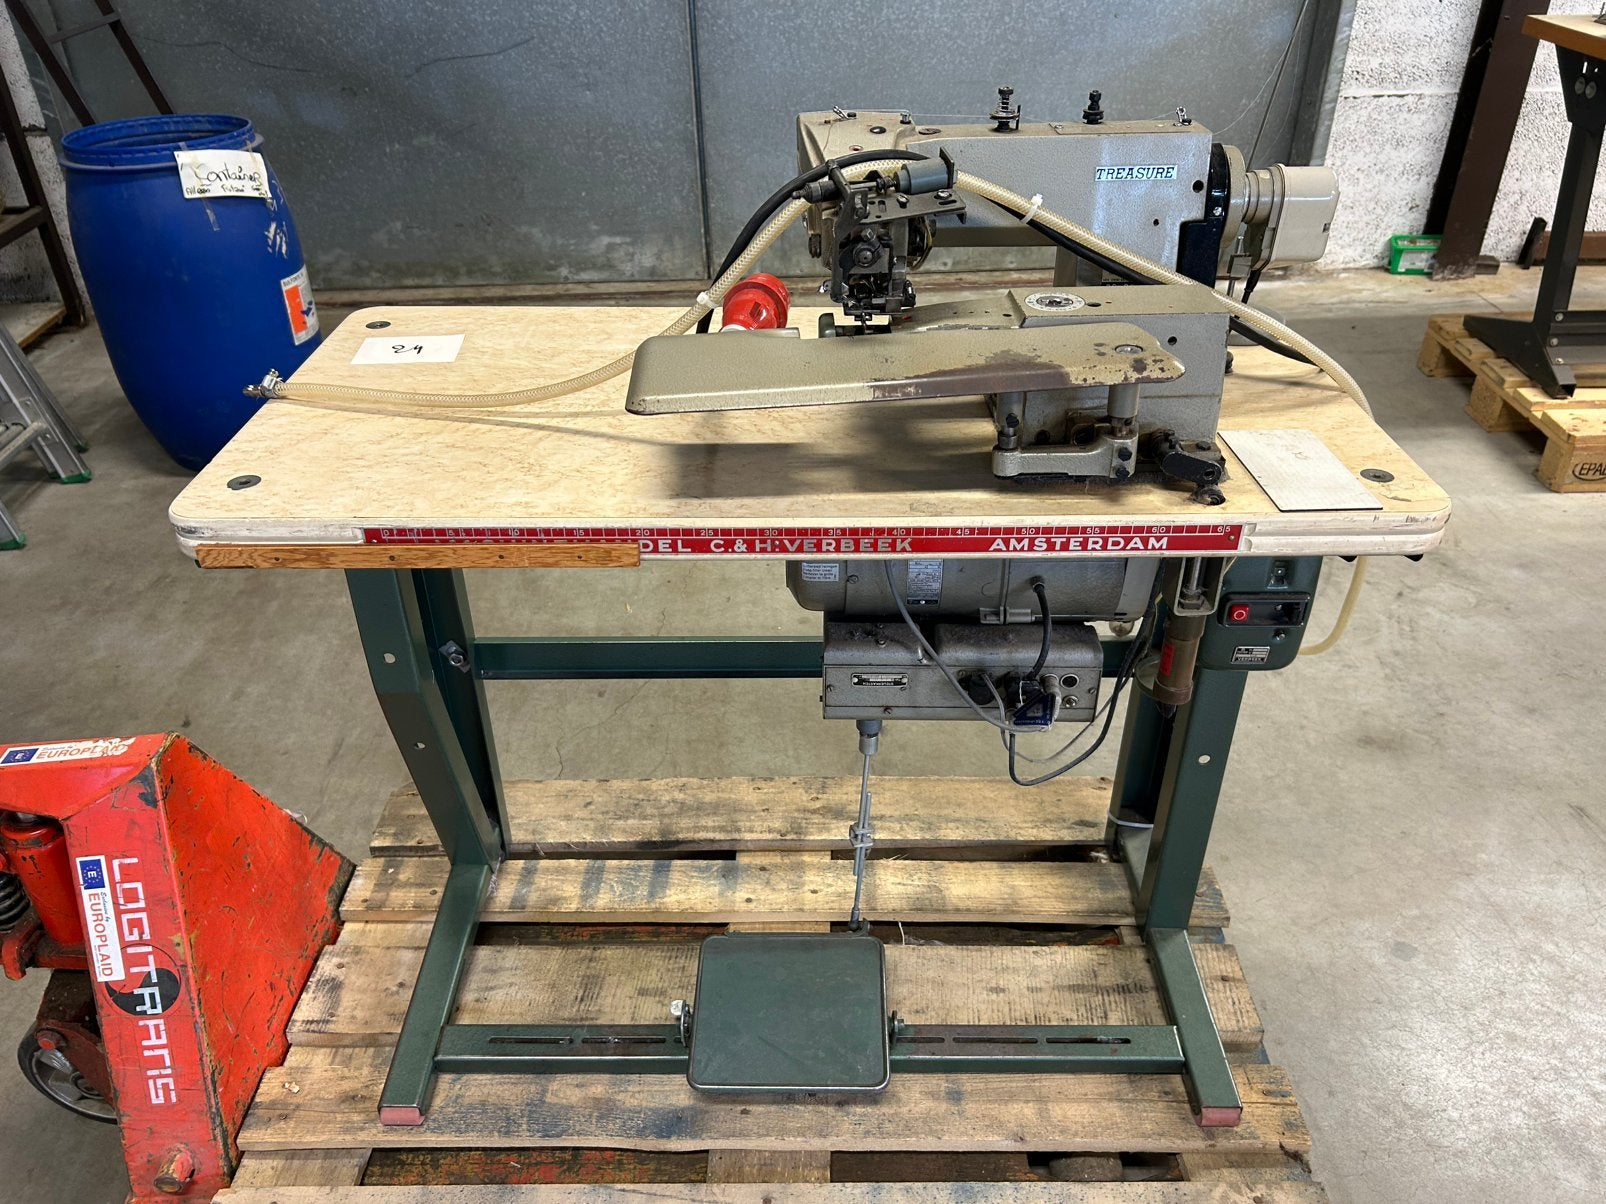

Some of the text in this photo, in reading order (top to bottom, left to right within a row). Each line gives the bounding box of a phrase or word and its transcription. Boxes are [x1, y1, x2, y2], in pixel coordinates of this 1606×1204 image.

[1096, 166, 1175, 180] TREASURE
[391, 344, 424, 355] 24
[988, 536, 1169, 551] AMSTERDAM
[88, 892, 113, 977] EUROPLAID
